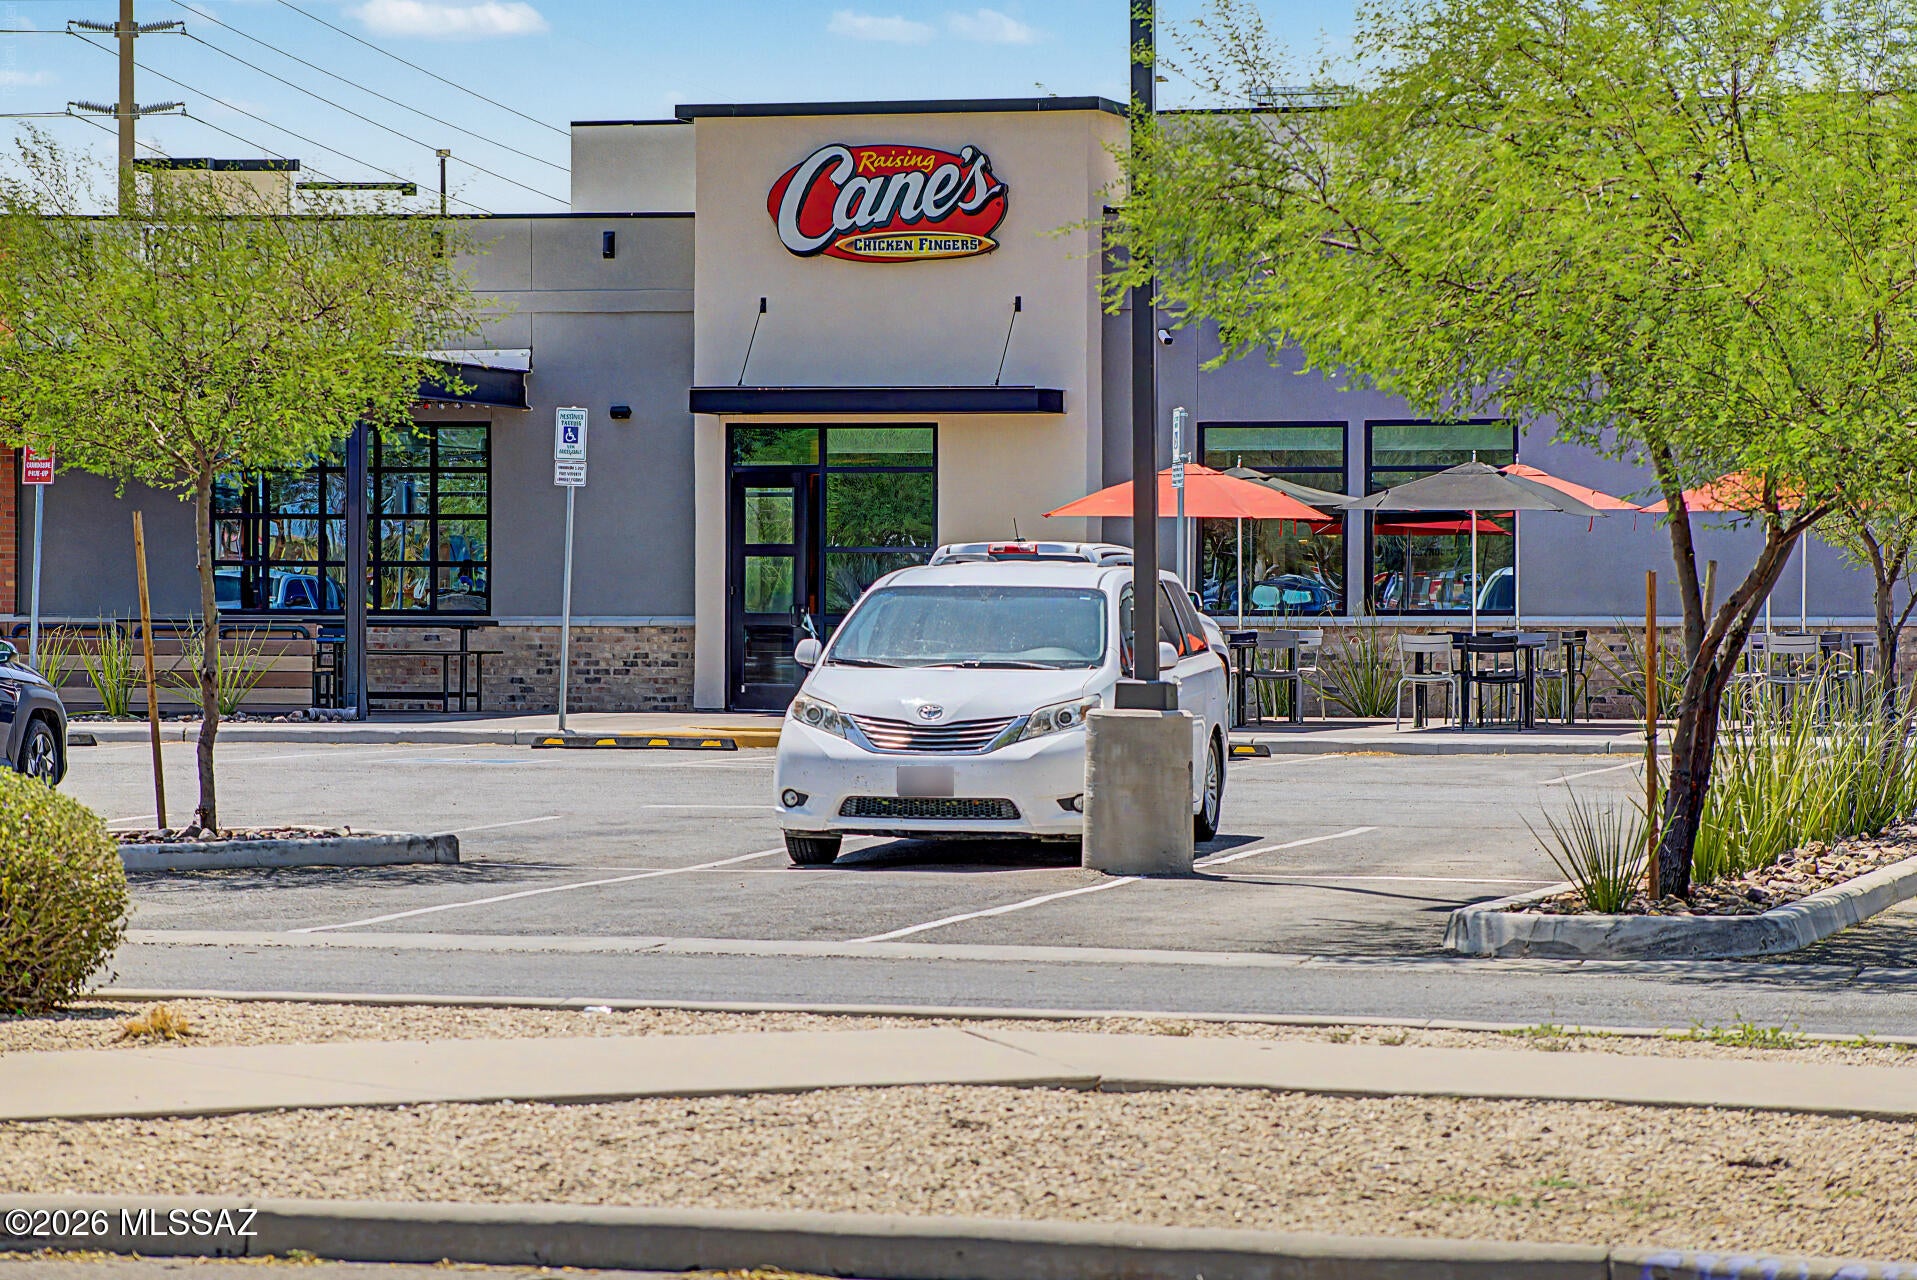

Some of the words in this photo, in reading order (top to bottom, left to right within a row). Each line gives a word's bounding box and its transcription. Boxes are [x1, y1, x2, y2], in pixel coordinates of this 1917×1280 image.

[858, 151, 936, 173] Raising
[777, 145, 1002, 252] Cane's
[854, 238, 914, 252] CHICKEN
[918, 238, 979, 252] FINGERS
